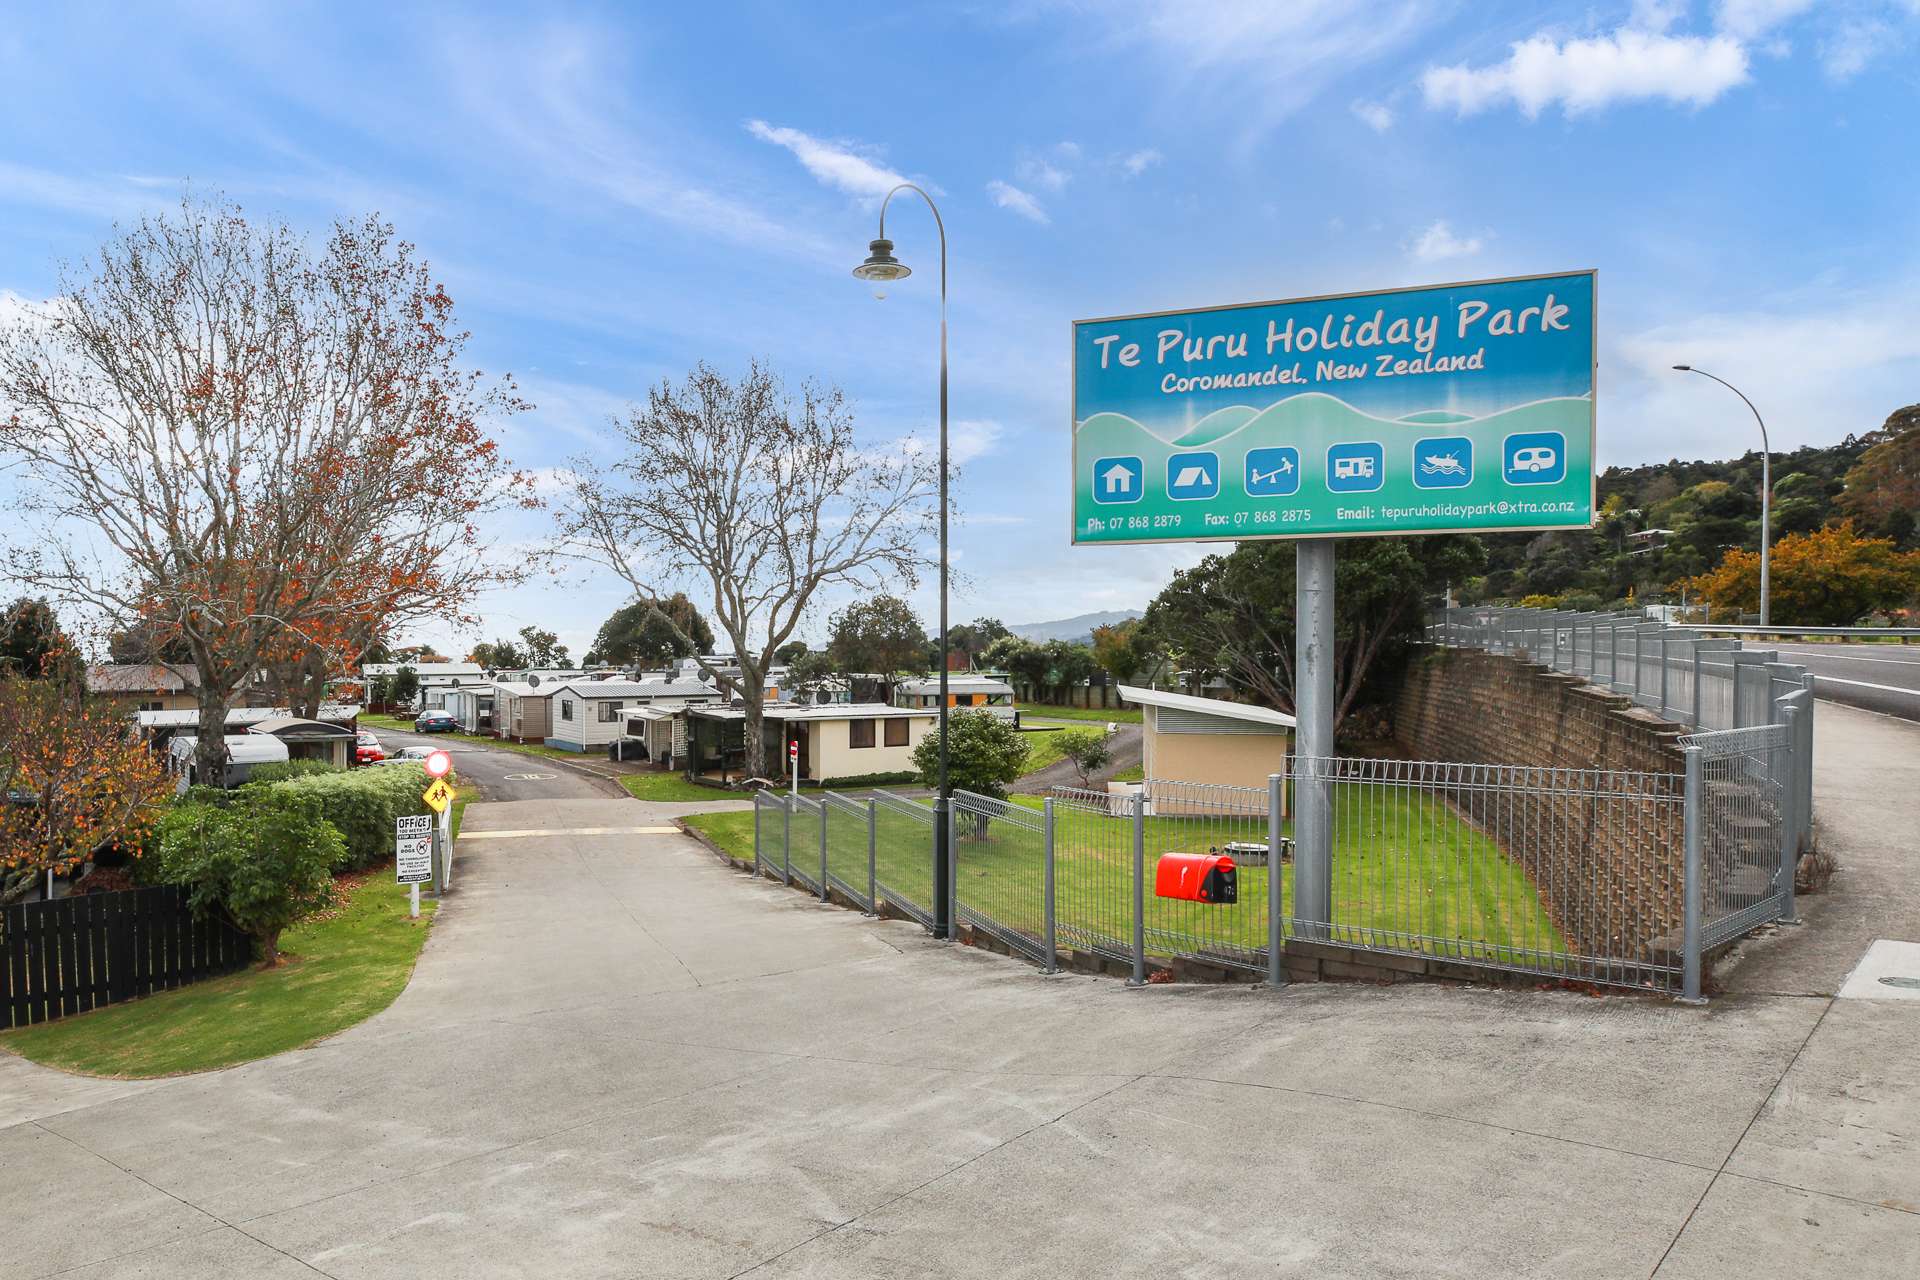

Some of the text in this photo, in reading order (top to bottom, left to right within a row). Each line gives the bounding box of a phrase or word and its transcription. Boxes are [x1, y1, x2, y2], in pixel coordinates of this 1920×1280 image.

[1094, 294, 1570, 368] Te Puru Holiday Park
[1316, 359, 1367, 381] New
[1376, 348, 1485, 377] Zealand
[1087, 501, 1574, 531] Ph: 07 868 2879 Fax: 07 868 2875 Email: tepuruholidaypark@xtra.co.nz
[398, 817, 427, 829] OFFICE
